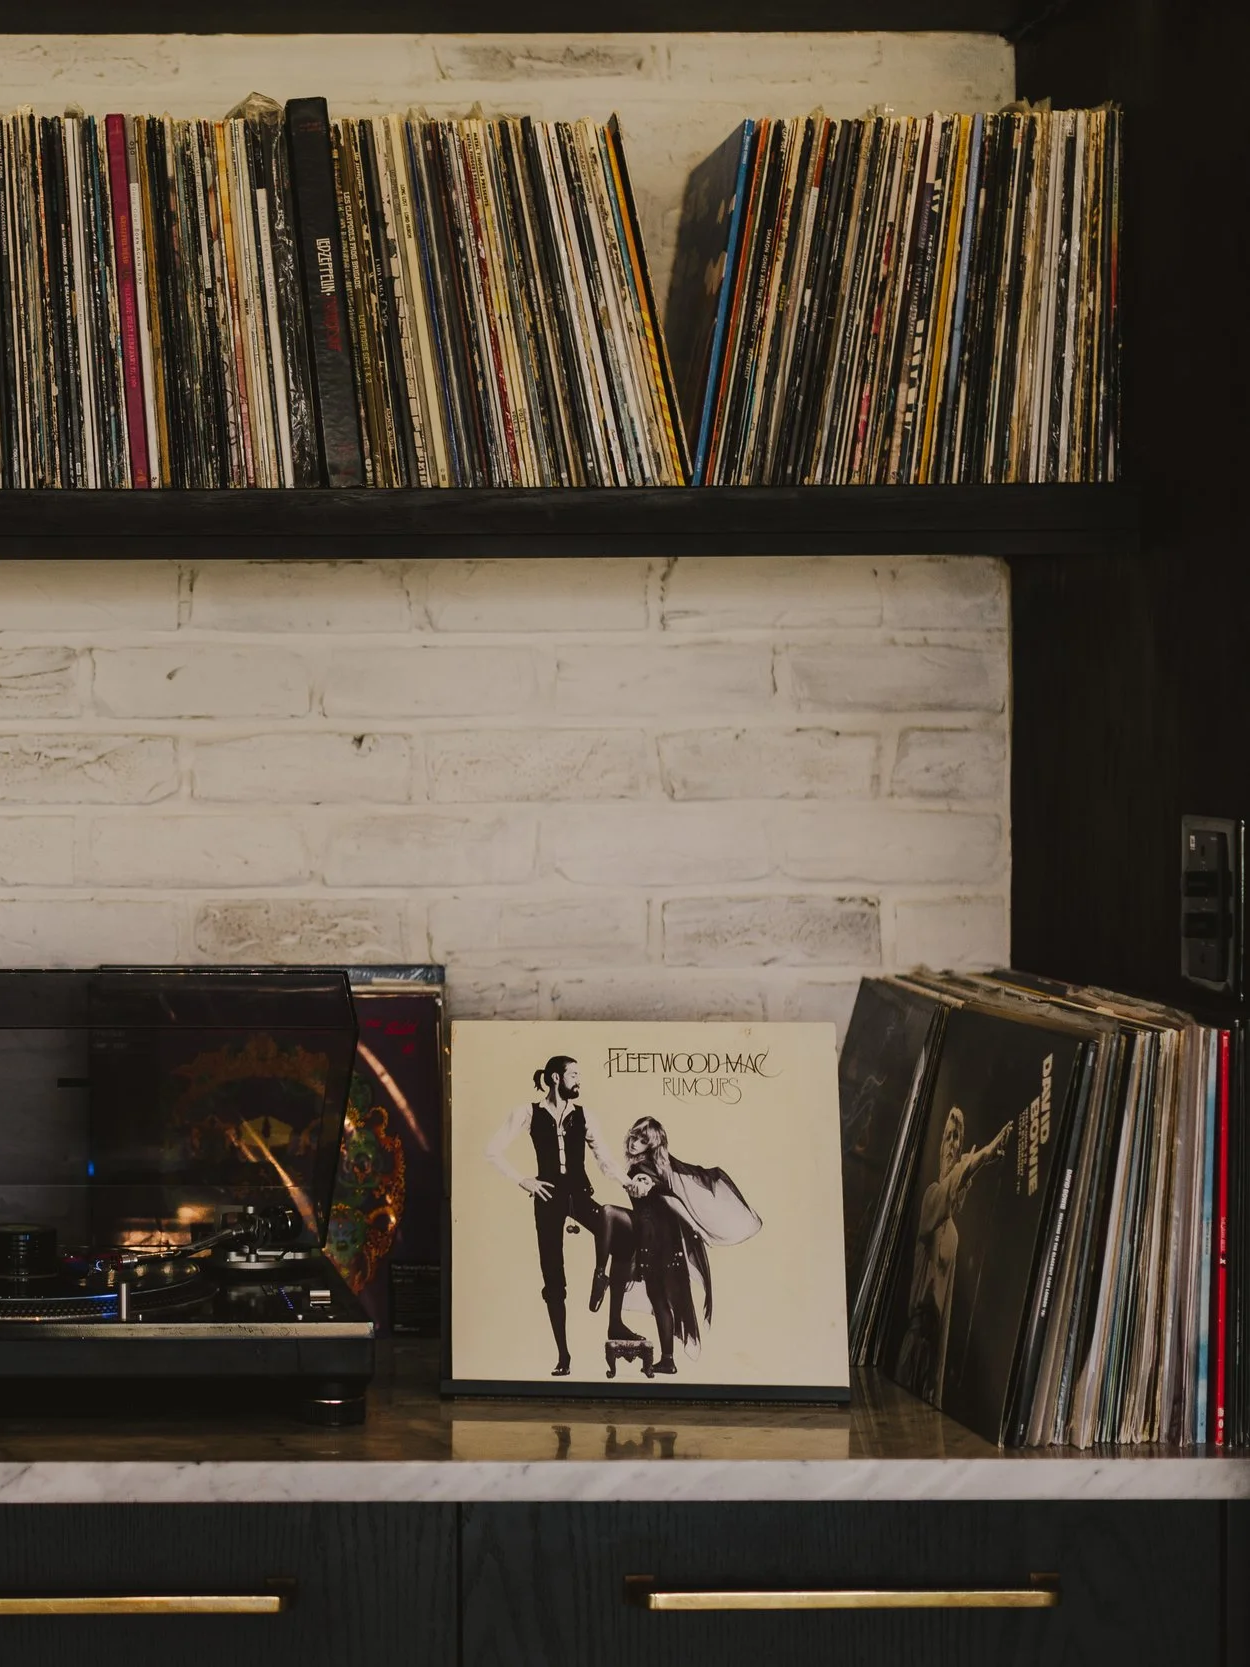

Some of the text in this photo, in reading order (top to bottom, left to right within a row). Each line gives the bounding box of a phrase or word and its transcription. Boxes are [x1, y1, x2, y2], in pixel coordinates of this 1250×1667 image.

[475, 152, 484, 177] FINGERS
[574, 127, 586, 170] RADIOHEAD
[583, 178, 592, 204] COMPUTER
[472, 175, 481, 200] PRESENTS
[479, 178, 489, 207] PRESENTS
[344, 205, 355, 241] CLAYPOOLS
[349, 243, 357, 260] FROG
[764, 229, 772, 252] SHARON
[351, 261, 361, 290] BRIGADE
[761, 254, 769, 272] JONES
[360, 330, 368, 351] FROGS
[604, 1047, 783, 1078] FLEETWOOD MAC
[662, 1076, 742, 1105] RUMOURS
[1040, 1052, 1053, 1144] DAVID
[1028, 1096, 1041, 1197] BOWIE
[1064, 1168, 1073, 1188] DAVID
[1059, 1189, 1069, 1210] BOWIE
[1048, 1252, 1058, 1276] BLACKOUT
